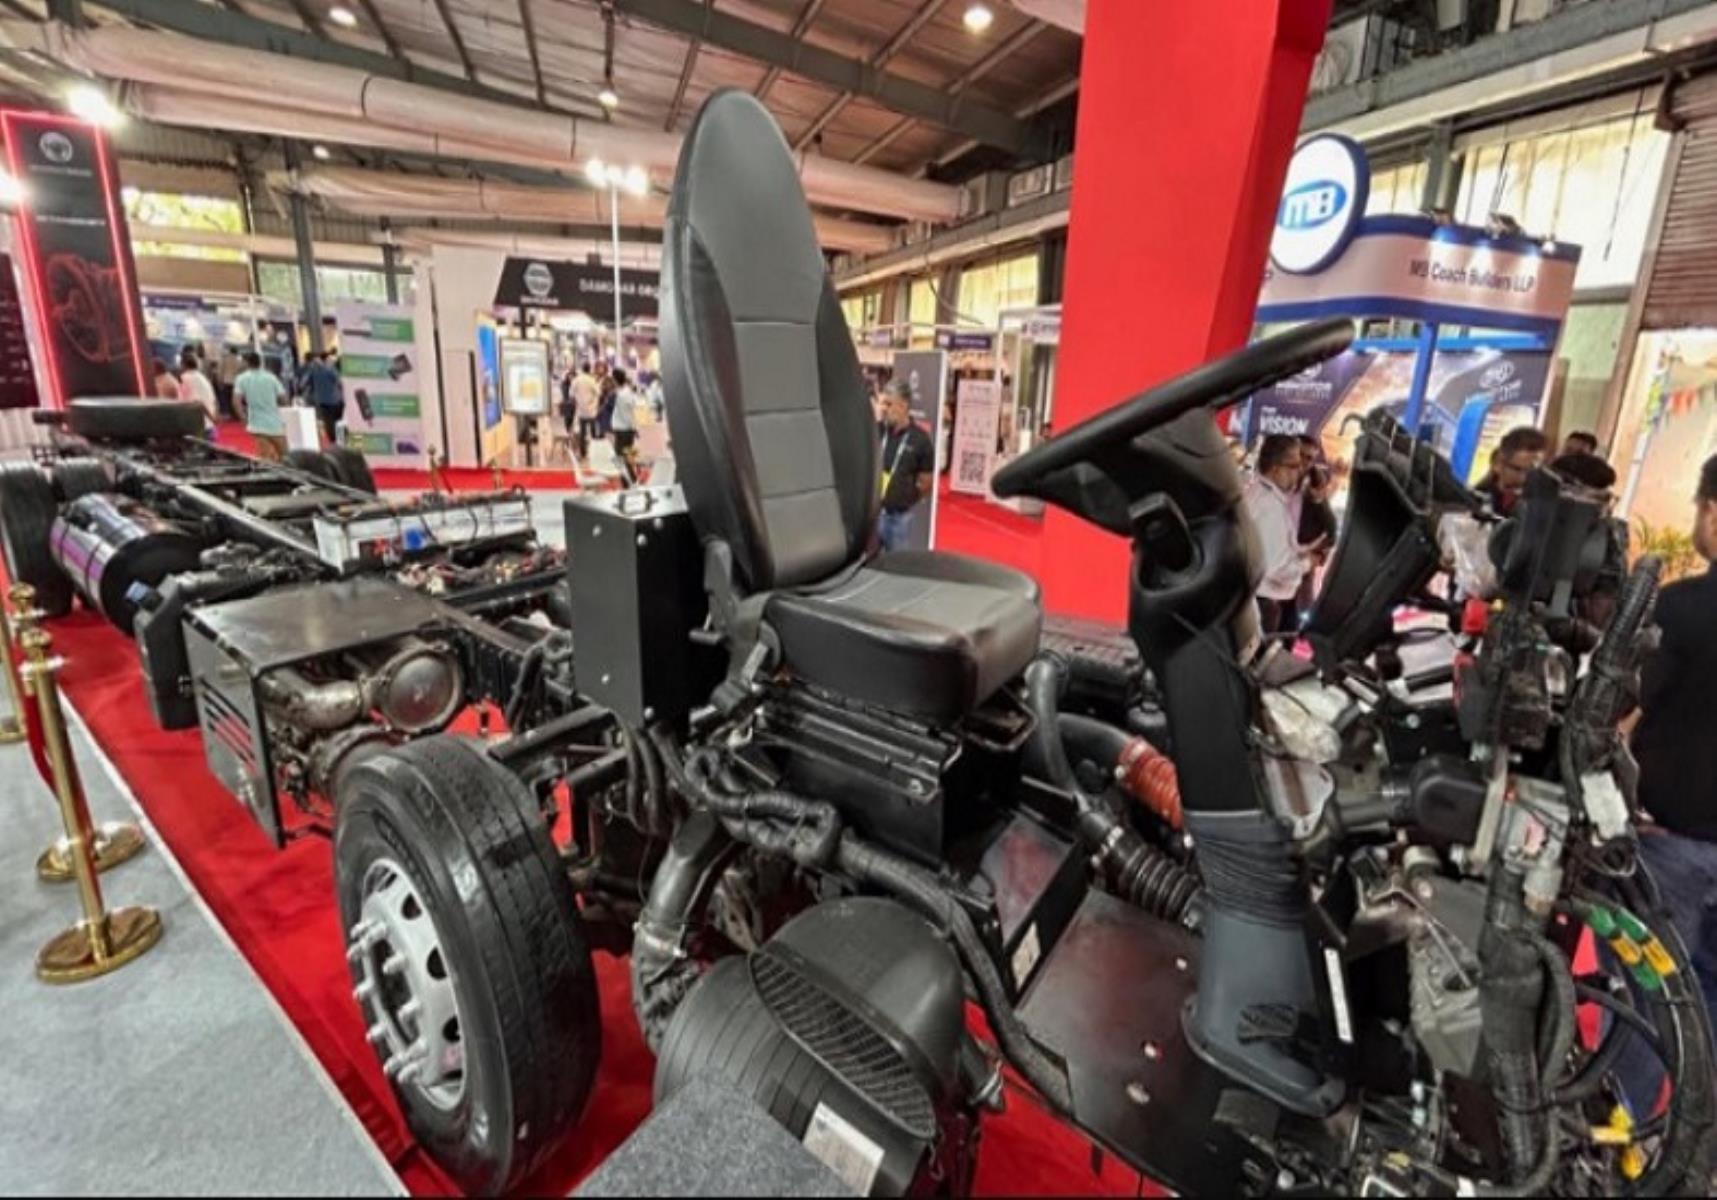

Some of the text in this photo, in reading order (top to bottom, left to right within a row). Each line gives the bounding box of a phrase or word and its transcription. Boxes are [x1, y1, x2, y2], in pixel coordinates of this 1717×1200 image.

[1432, 262, 1466, 281] Coach
[1468, 268, 1511, 291] Builders
[1513, 275, 1535, 293] LLP
[1260, 415, 1309, 435] VISION
